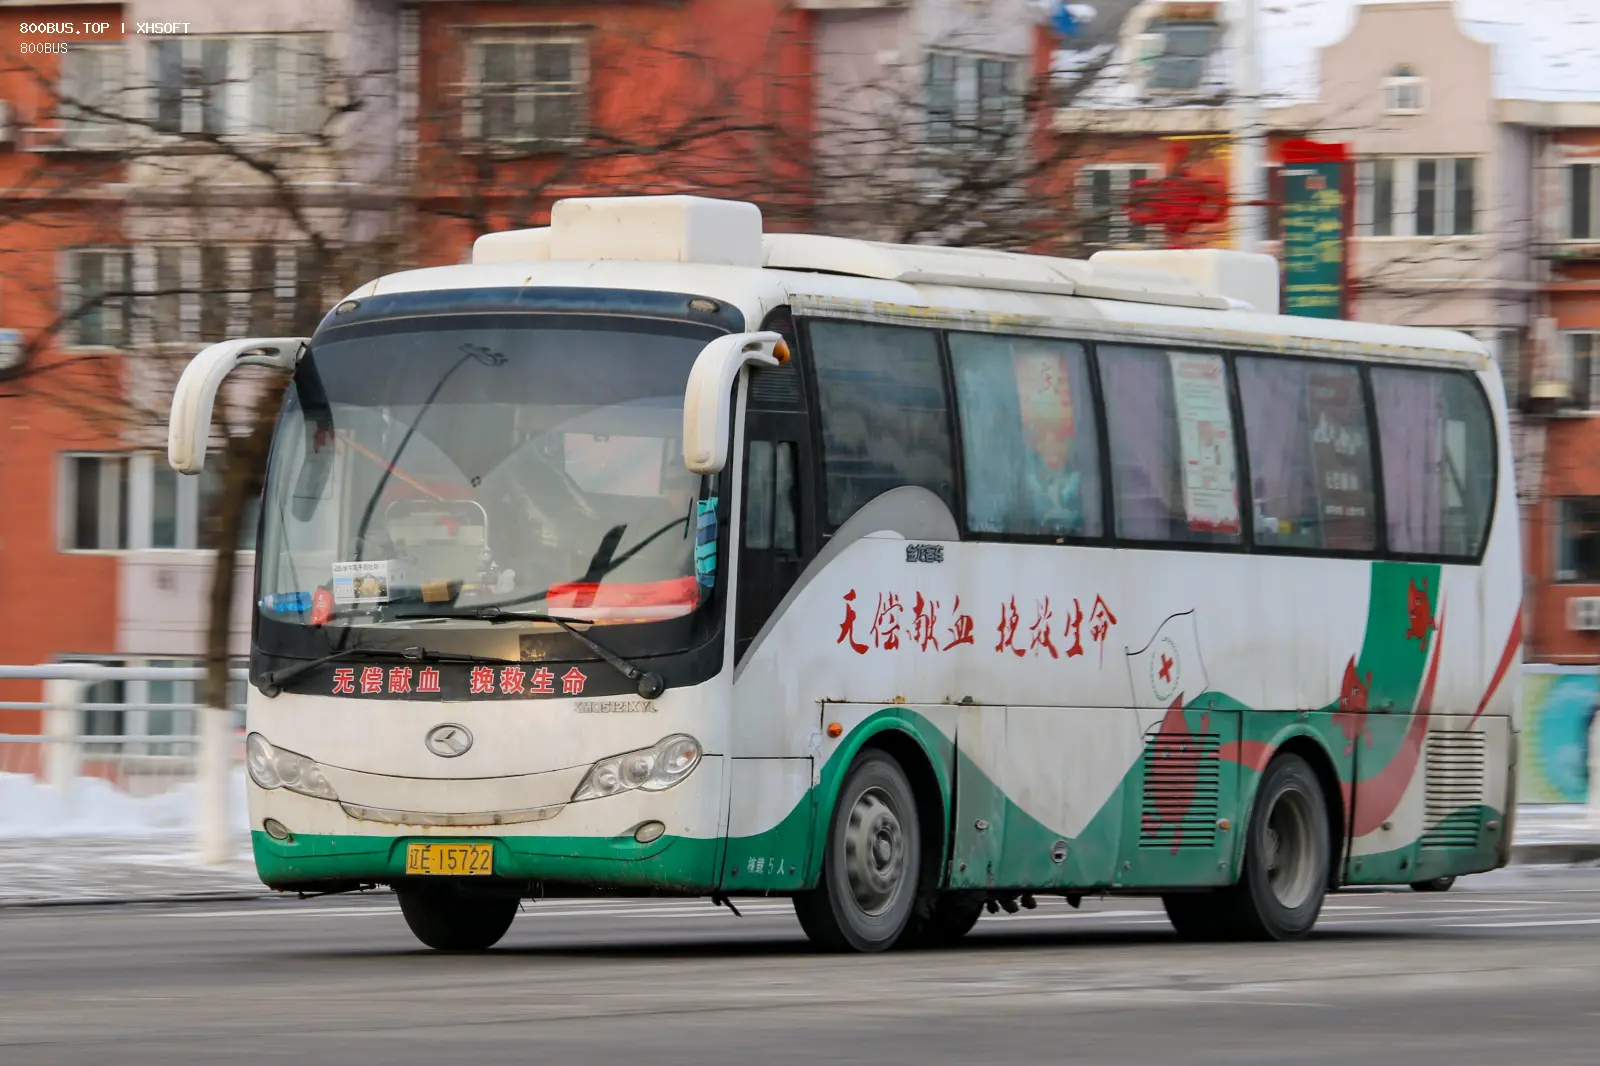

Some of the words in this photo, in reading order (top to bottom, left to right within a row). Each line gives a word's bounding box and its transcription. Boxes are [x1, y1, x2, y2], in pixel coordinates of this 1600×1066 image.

[836, 588, 974, 655] 无偿献血
[994, 593, 1118, 670] 挽救生命
[332, 667, 441, 694] 无偿献血
[470, 667, 588, 695] 挽救生命
